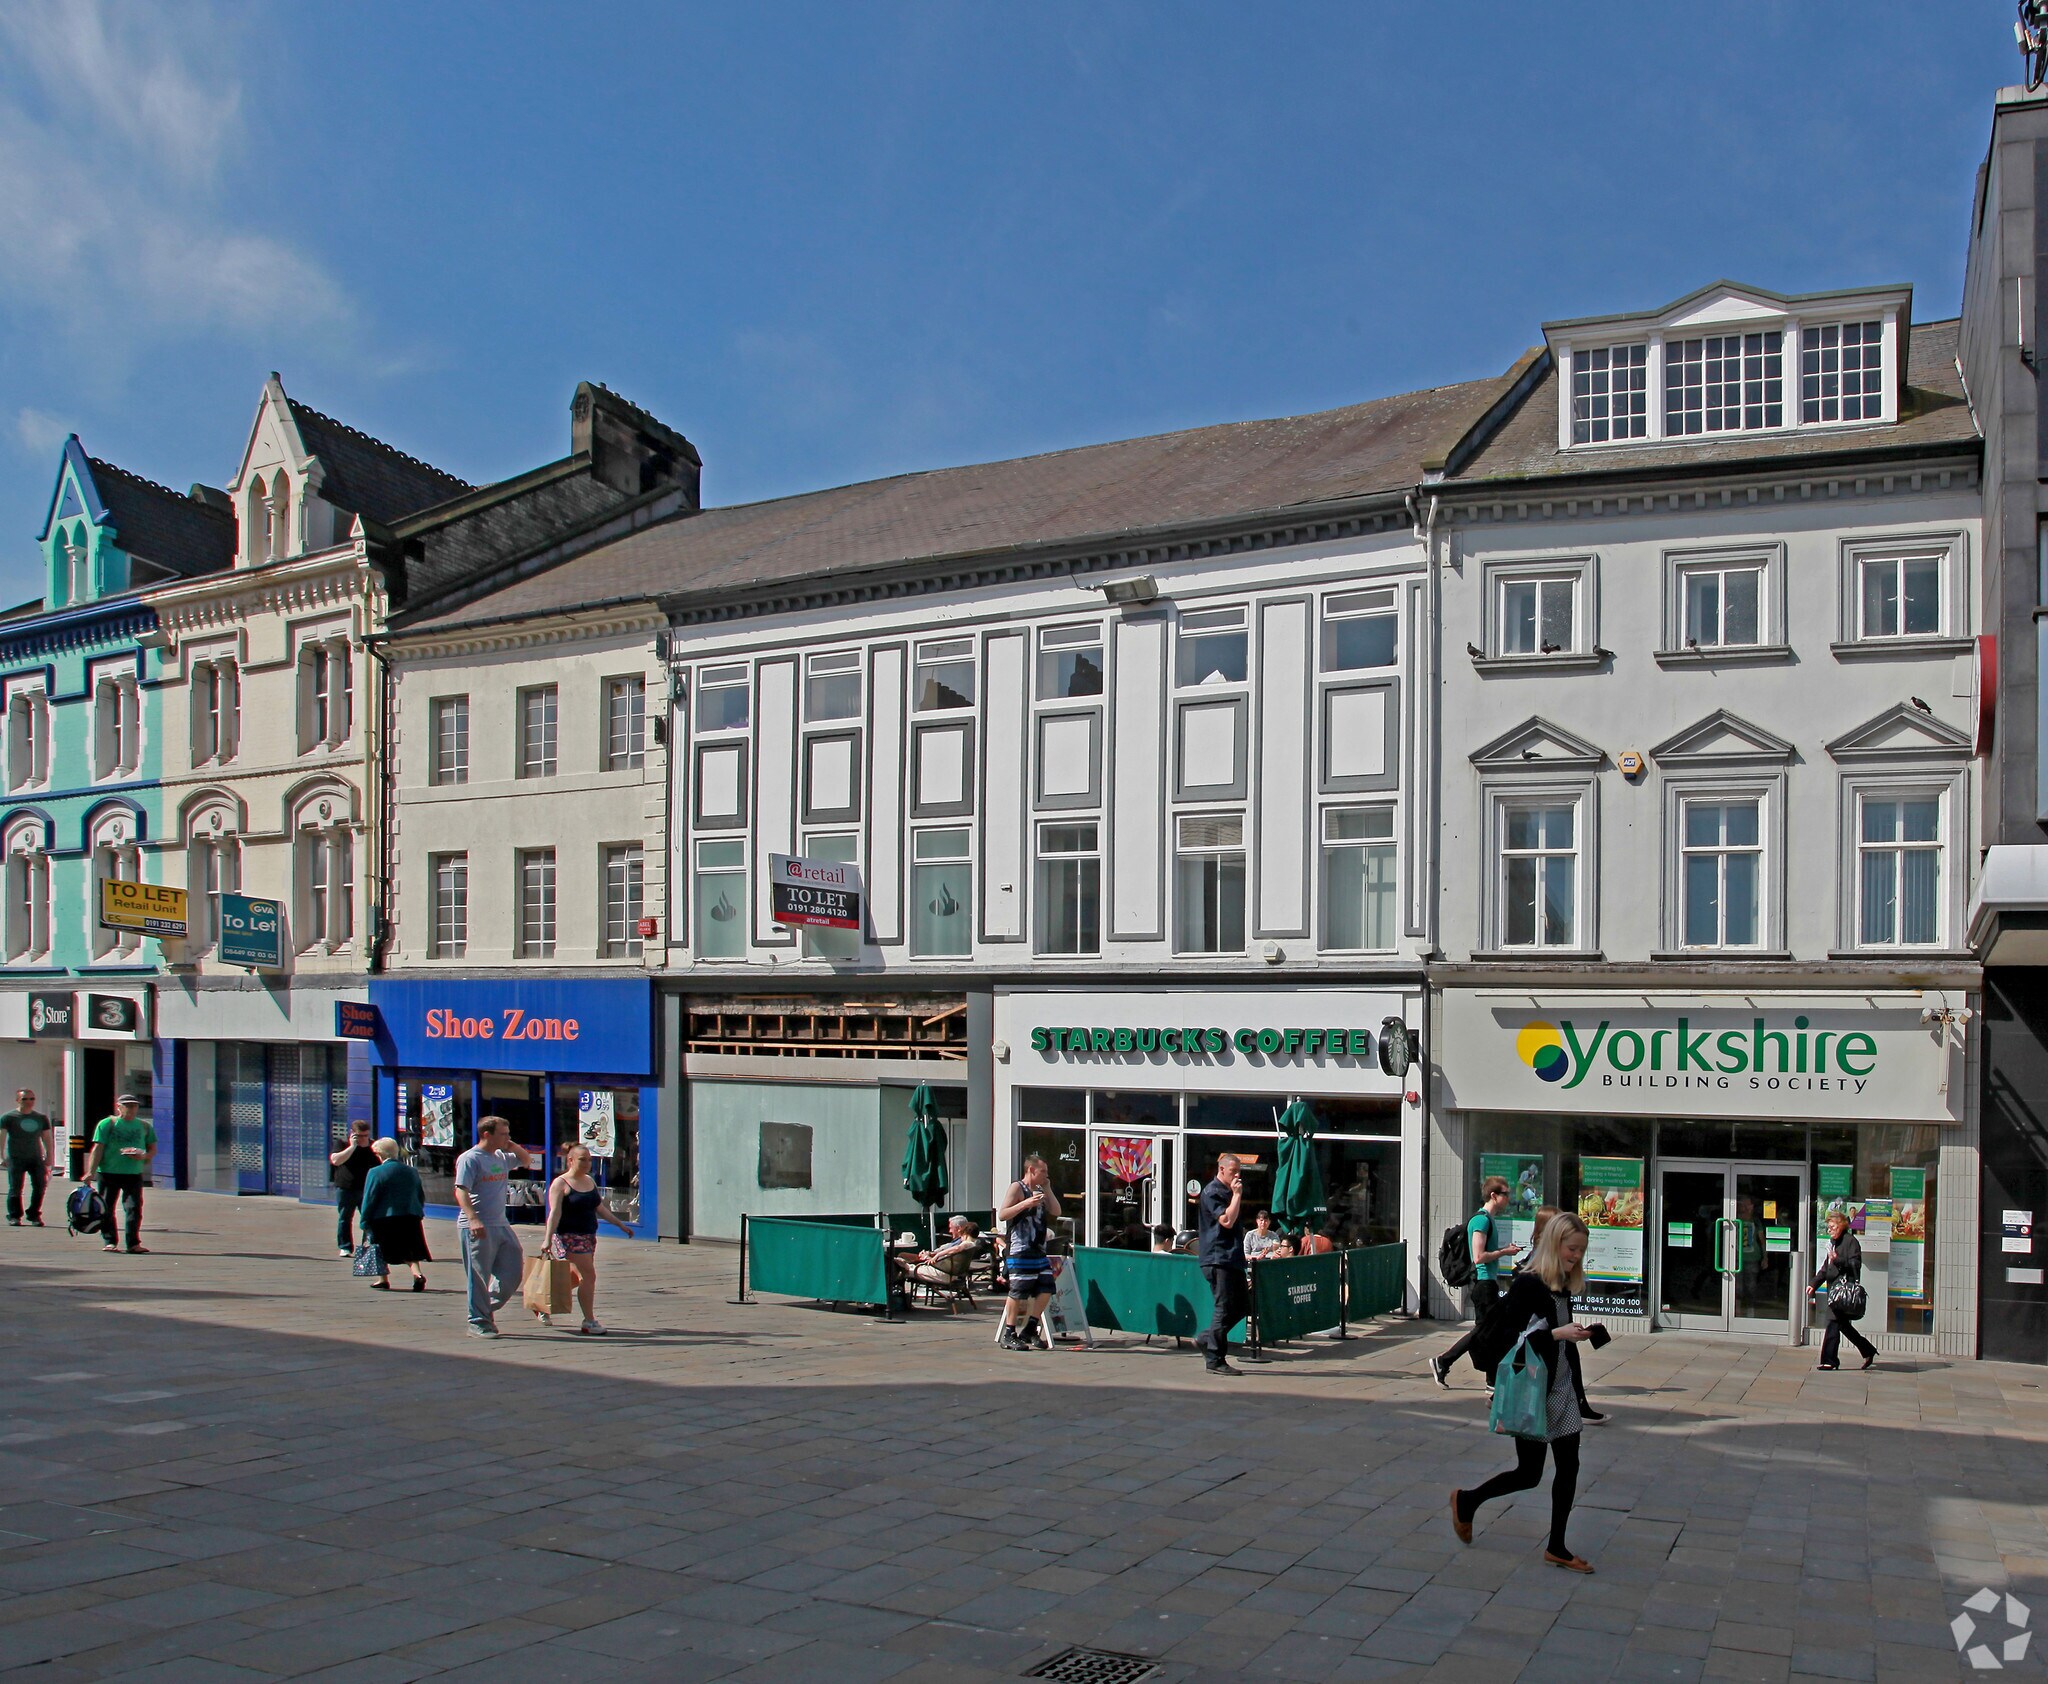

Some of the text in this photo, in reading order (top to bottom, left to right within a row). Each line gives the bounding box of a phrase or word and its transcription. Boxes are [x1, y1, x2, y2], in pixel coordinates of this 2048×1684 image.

[108, 882, 182, 903] TO LET
[787, 888, 847, 907] TO LET
[114, 899, 177, 914] Retail Unit
[253, 905, 275, 915] GVA
[787, 903, 848, 917] 0191 280 4120
[172, 922, 186, 930] 6291
[223, 914, 277, 932] To Let
[32, 999, 68, 1031] 3 Store
[100, 1000, 125, 1026] 3
[342, 1005, 374, 1021] Shoe
[342, 1020, 374, 1037] Zone
[426, 1008, 579, 1040] Shoe Zone
[1031, 1026, 1369, 1055] STARBUCKS COFFEE
[1603, 1074, 1867, 1094] BUILDING SOCIETY
[1288, 1283, 1317, 1296] STARBUCKS
[1293, 1293, 1311, 1304] COFFEE
[1586, 1296, 1604, 1304] 0845
[1592, 1305, 1643, 1315] www.ybs.co.uk
